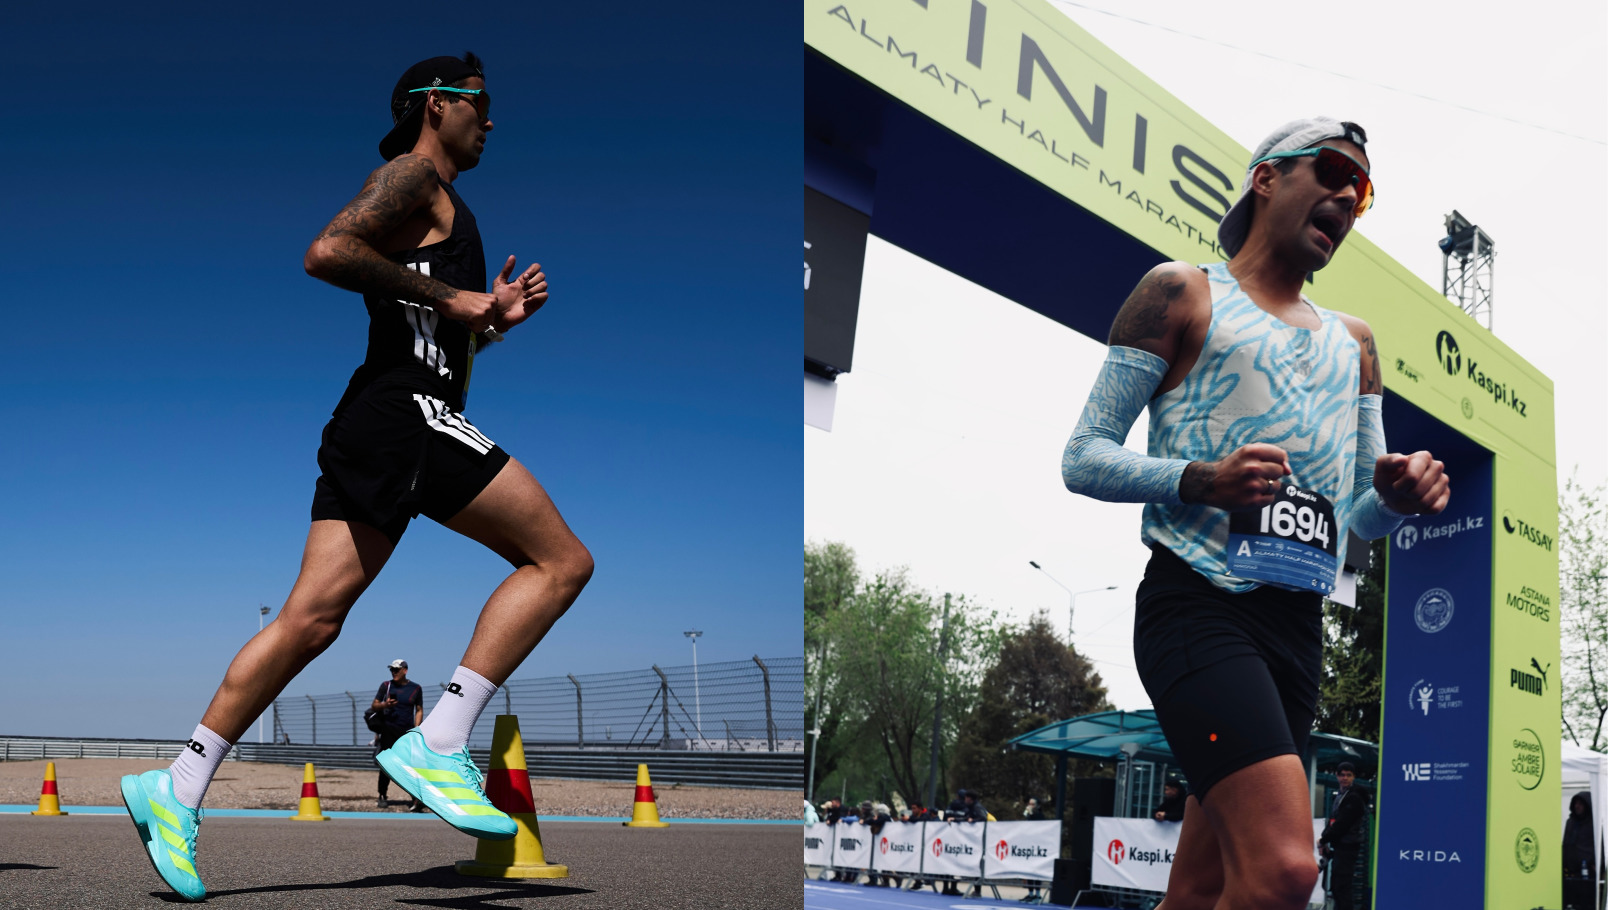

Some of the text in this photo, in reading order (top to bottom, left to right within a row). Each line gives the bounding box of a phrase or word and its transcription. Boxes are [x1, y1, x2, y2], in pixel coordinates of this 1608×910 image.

[827, 4, 991, 109] ALMATY
[1001, 109, 1091, 171] HALF
[1467, 358, 1527, 418] Kaspi.kz
[1260, 500, 1330, 549] 1694
[1423, 516, 1484, 541] Kaspi.kz
[1517, 519, 1553, 552] TASSAY
[1236, 540, 1252, 557] A
[1520, 585, 1550, 606] ASTANA
[1506, 593, 1550, 622] MOTORS
[1510, 668, 1543, 696] PUMA
[1513, 739, 1540, 754] GARNIER
[1511, 759, 1540, 777] SOLAIRE
[1517, 753, 1540, 767] AMBRE
[890, 841, 914, 854] Kaspi.kz
[944, 843, 973, 857] Kaspi.kz
[1011, 845, 1047, 860] Kaspi.kz
[1399, 849, 1461, 863] KRIDA
